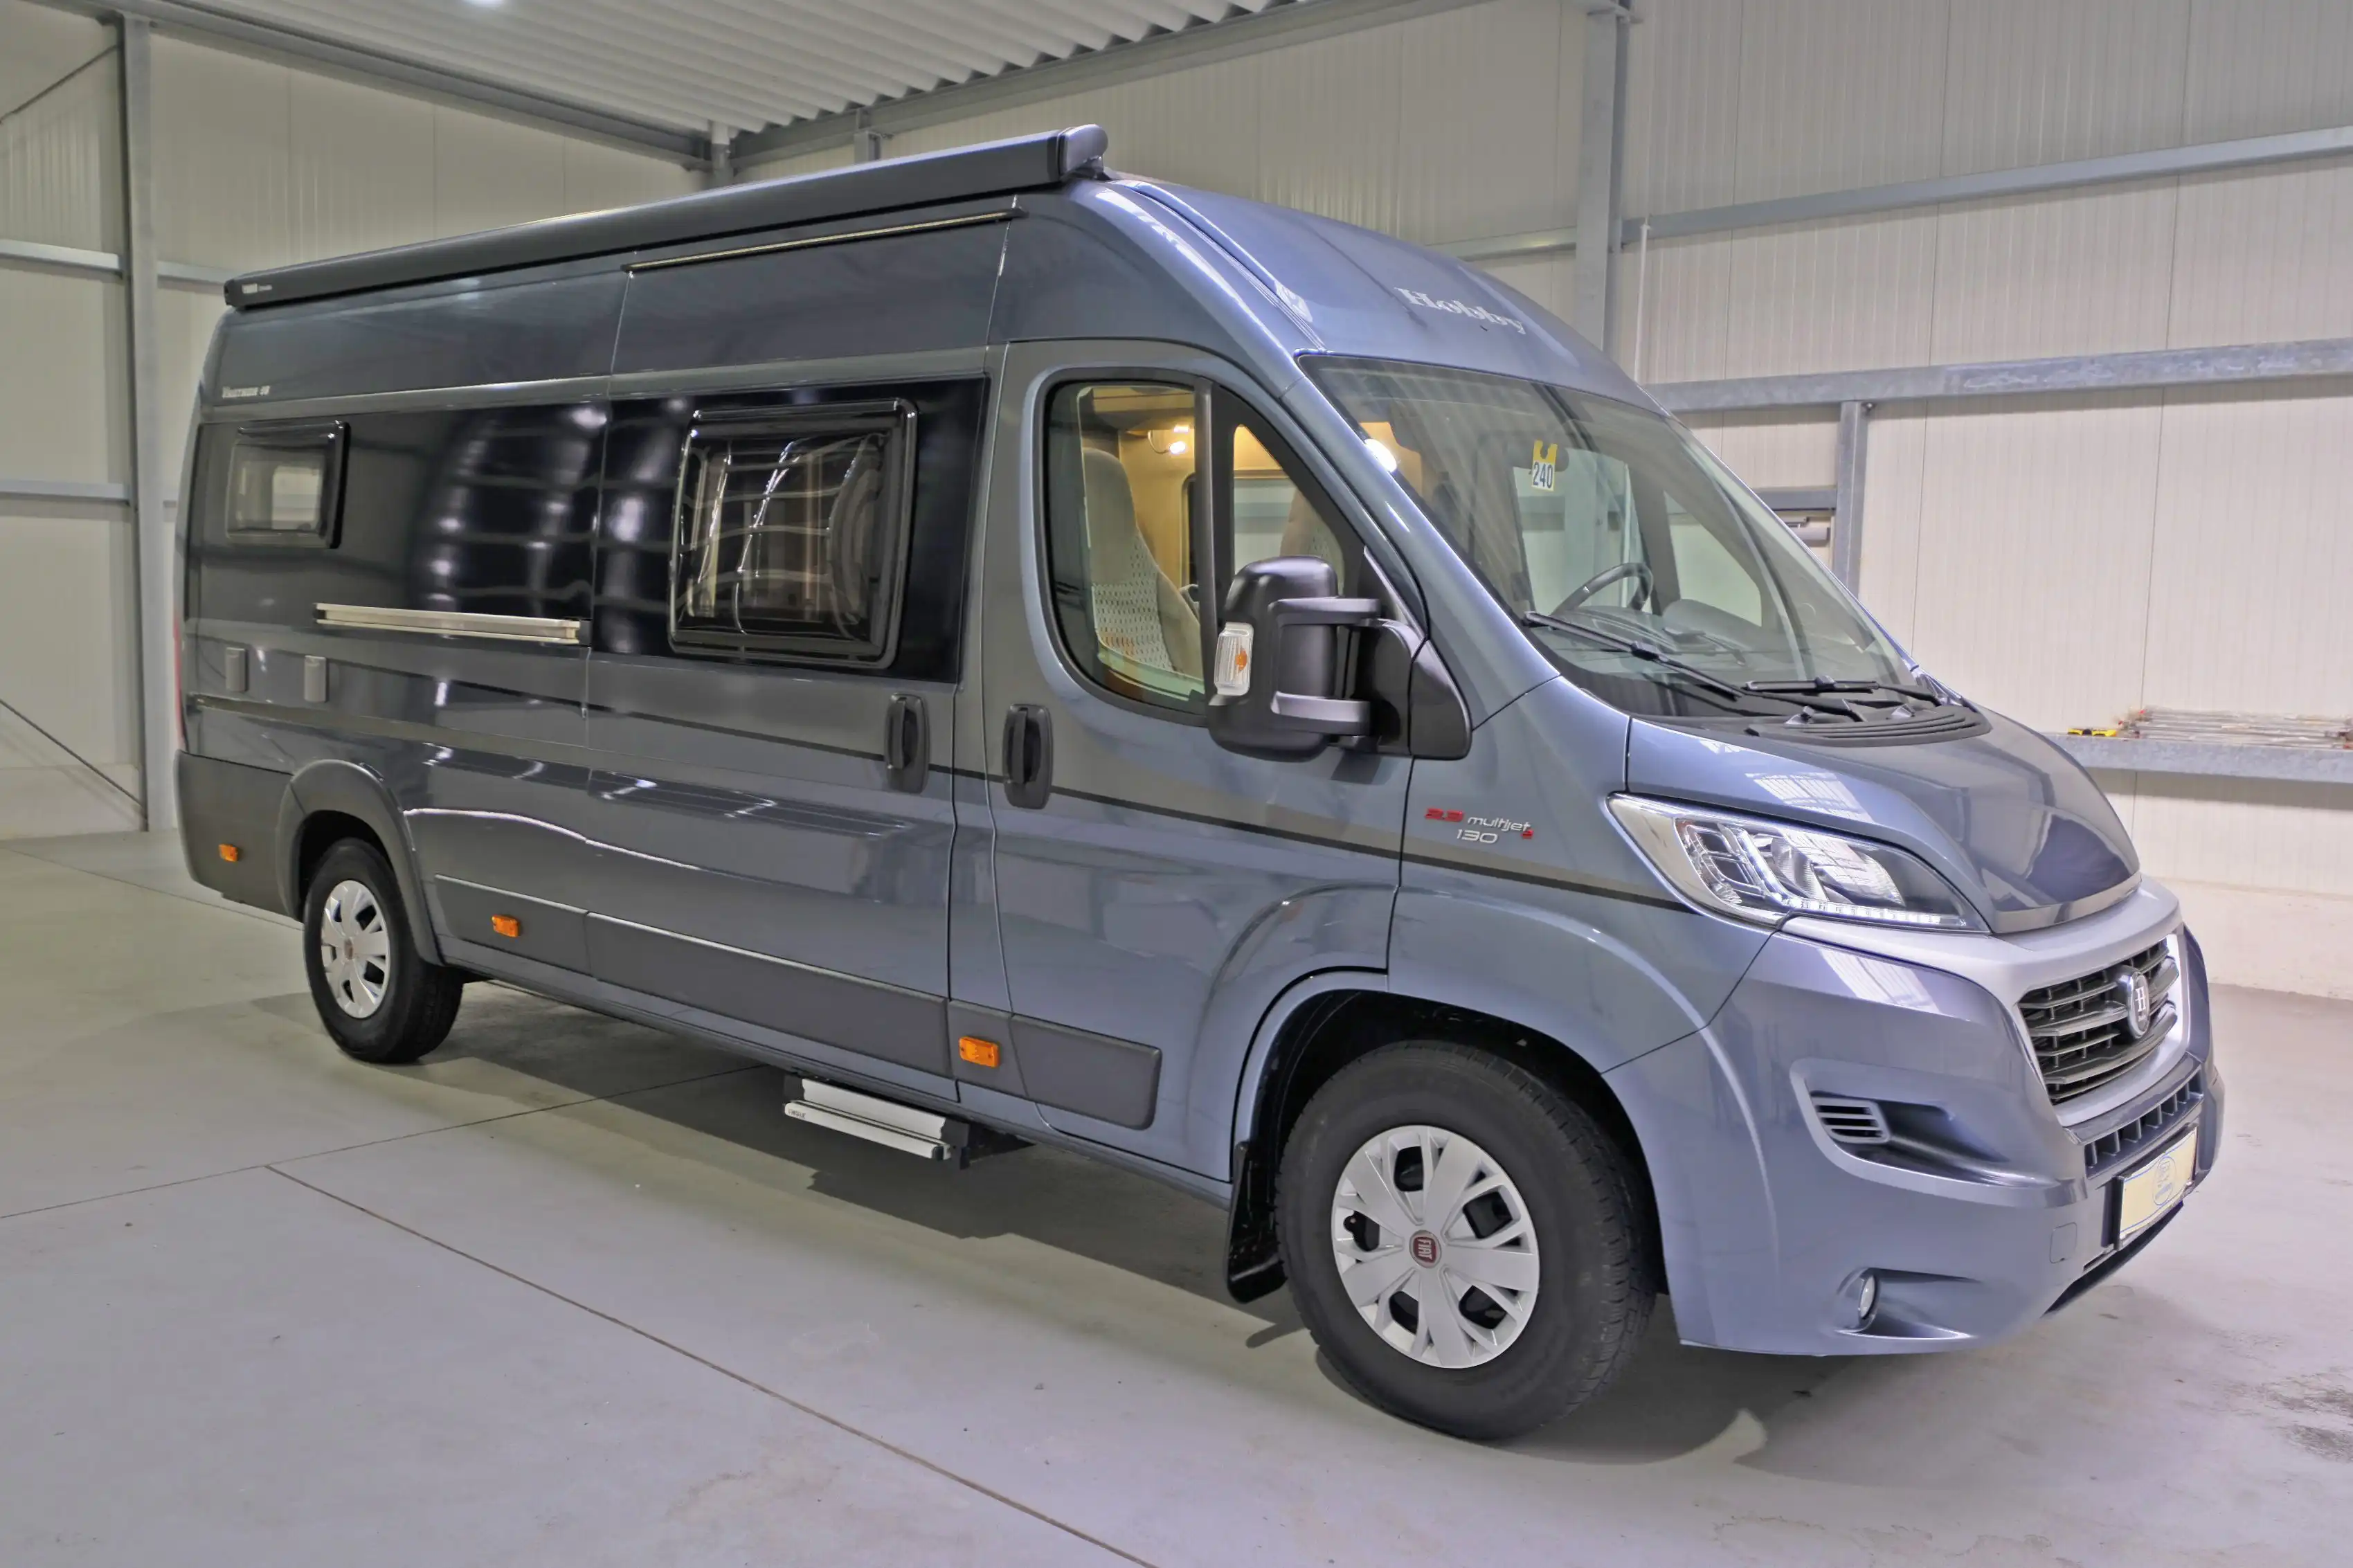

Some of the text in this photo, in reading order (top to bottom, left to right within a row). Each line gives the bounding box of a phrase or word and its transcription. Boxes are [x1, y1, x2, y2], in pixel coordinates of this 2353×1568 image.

[1394, 287, 1526, 335] Hobby
[1533, 462, 1553, 489] 240
[1468, 817, 1531, 831] multijet
[1457, 829, 1497, 844] 130
[1417, 1238, 1432, 1260] FIAT
